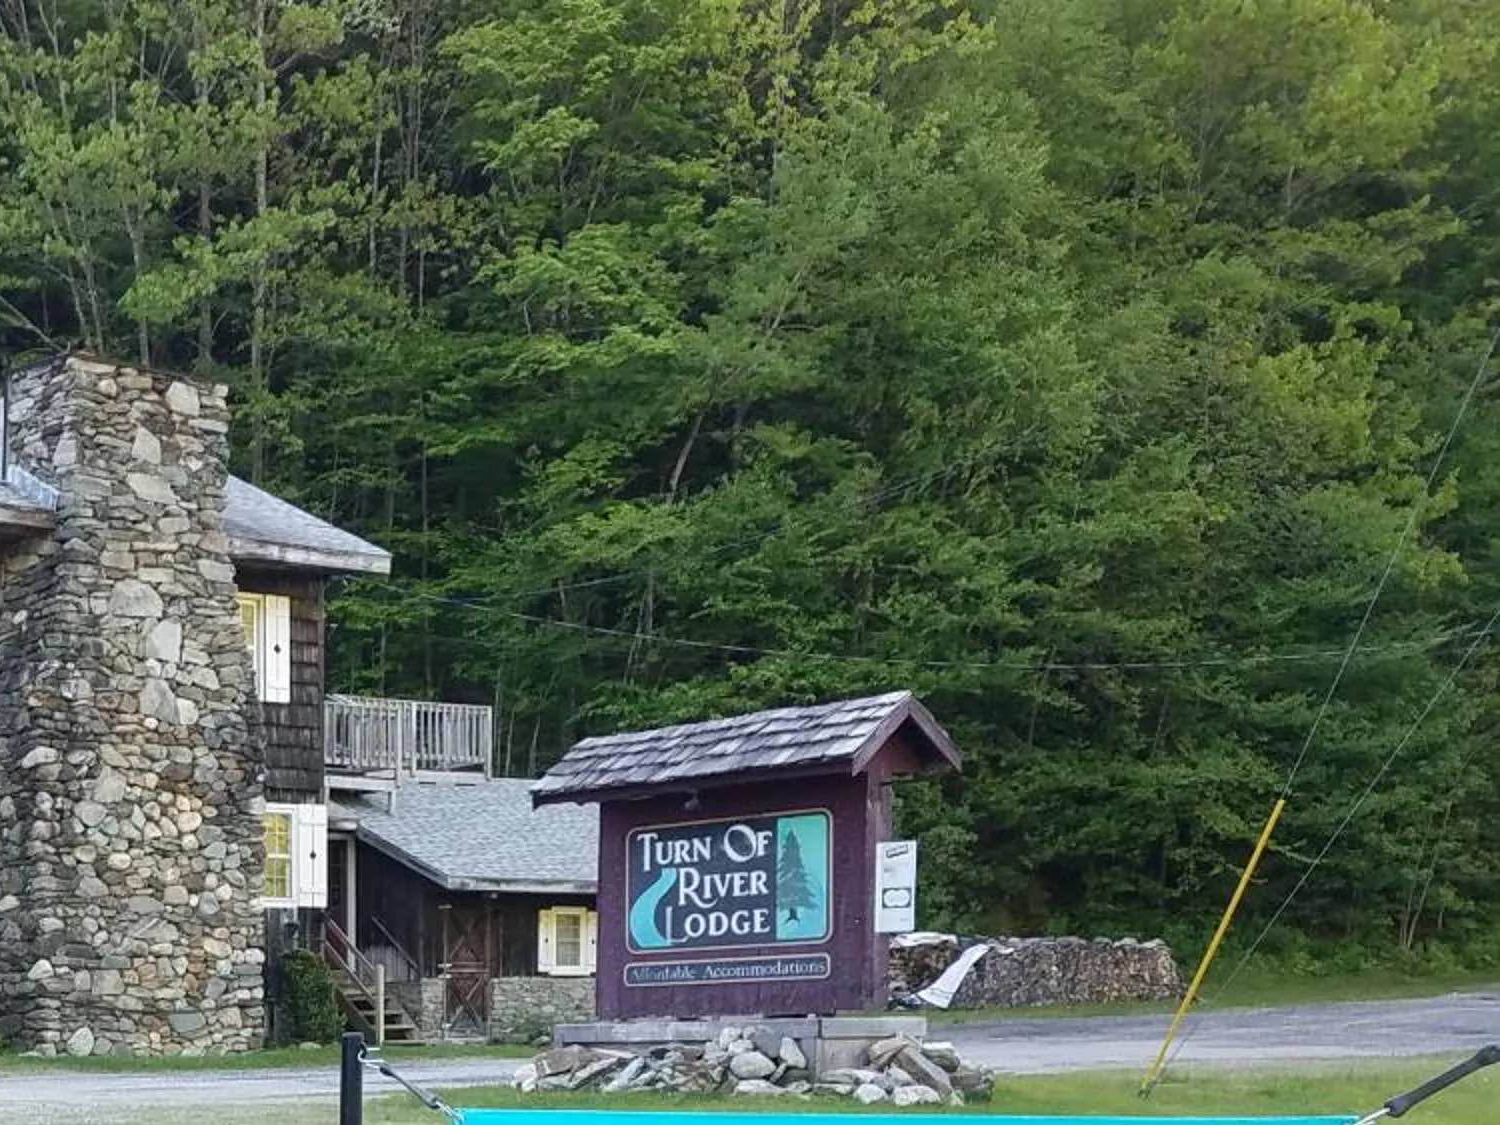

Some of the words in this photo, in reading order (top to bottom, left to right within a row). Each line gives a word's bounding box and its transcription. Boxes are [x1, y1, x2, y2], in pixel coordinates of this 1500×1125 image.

[637, 832, 712, 871] TURN
[678, 867, 769, 909] RIVER
[665, 906, 771, 943] LODGE
[703, 960, 827, 979] Accommodations
